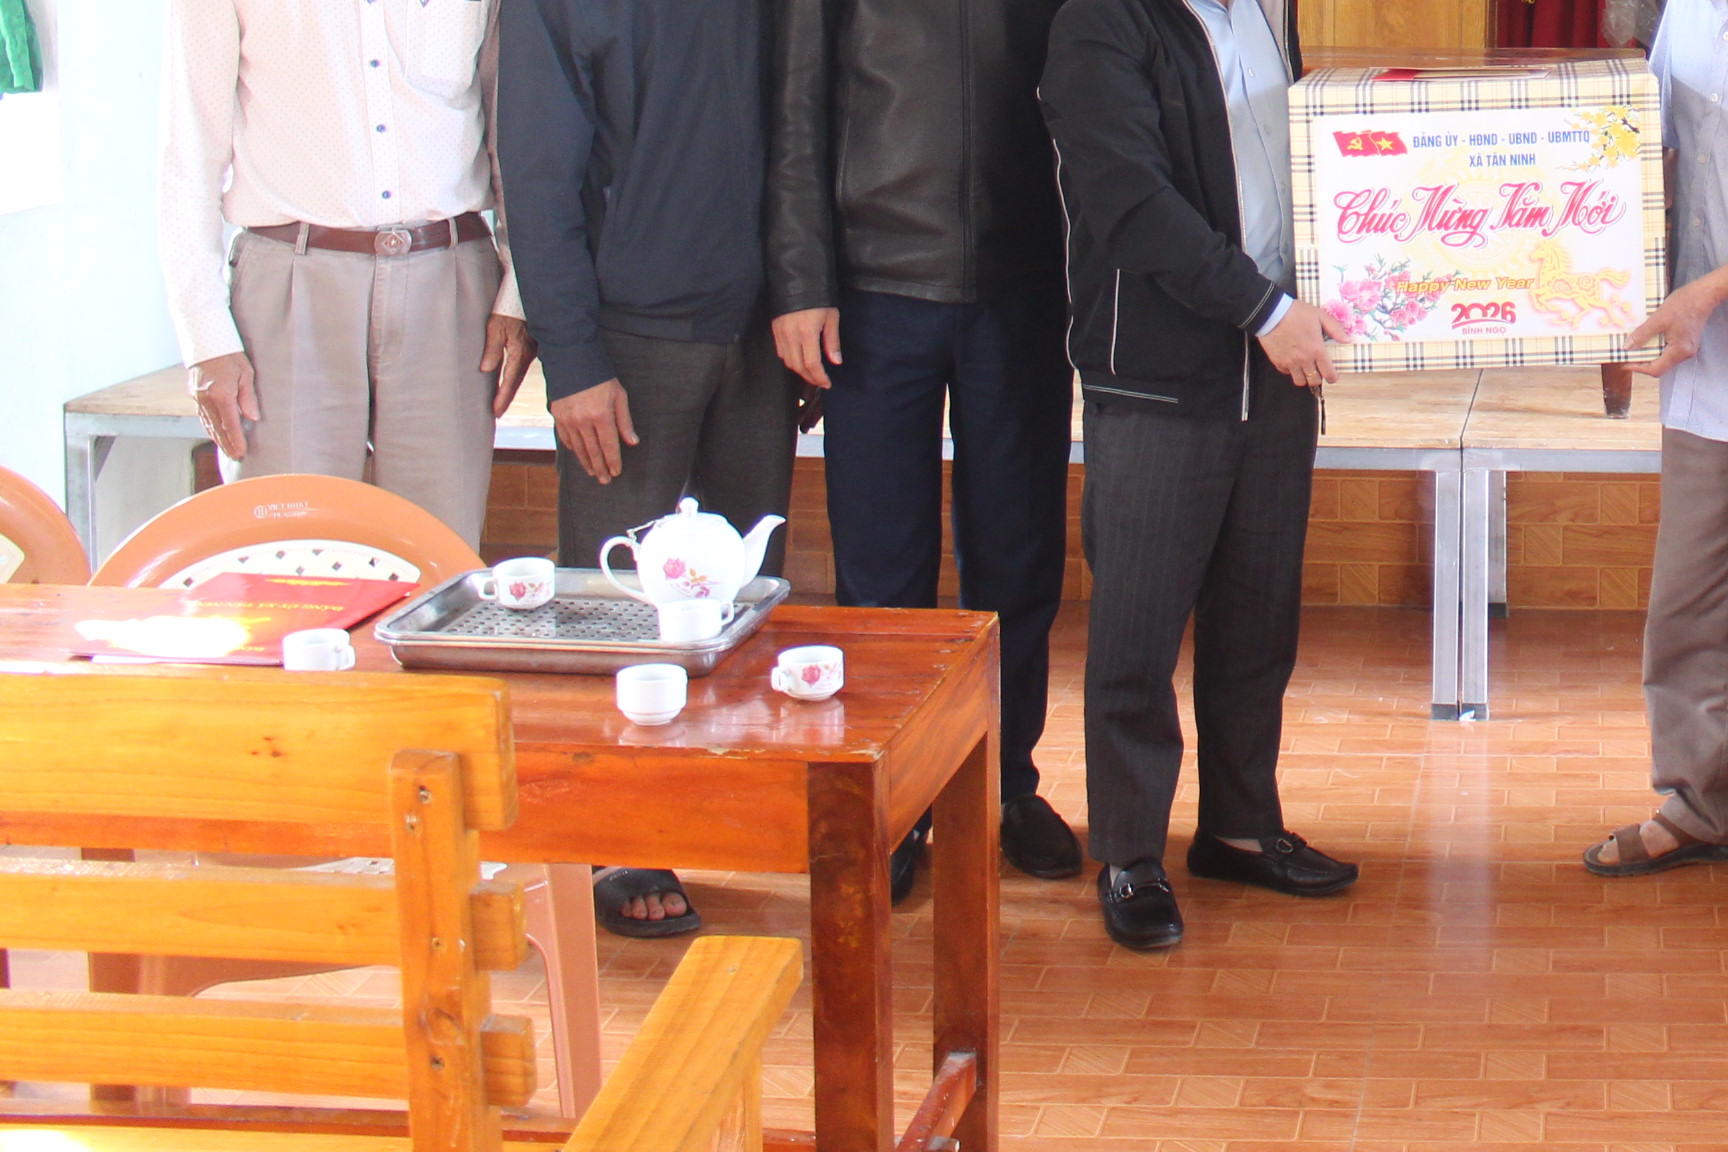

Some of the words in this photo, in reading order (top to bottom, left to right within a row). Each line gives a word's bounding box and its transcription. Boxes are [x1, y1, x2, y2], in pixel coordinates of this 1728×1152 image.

[1413, 131, 1441, 148] ĐẢNG
[1445, 130, 1458, 147] ỦY
[1469, 134, 1497, 145] HĐND
[1509, 132, 1537, 144] UBND
[1548, 130, 1589, 143] UBMTTQ
[1470, 155, 1482, 167] XÃ
[1486, 155, 1506, 166] TÂN
[1510, 154, 1535, 165] NINH
[1334, 187, 1411, 242] Chúc
[1395, 184, 1491, 247] Mừng
[1491, 181, 1549, 234] Năm
[1542, 179, 1626, 237] Mới
[1397, 280, 1449, 295] Happy
[1455, 278, 1490, 290] New
[1496, 277, 1534, 289] Year
[1451, 301, 1517, 325] 2026
